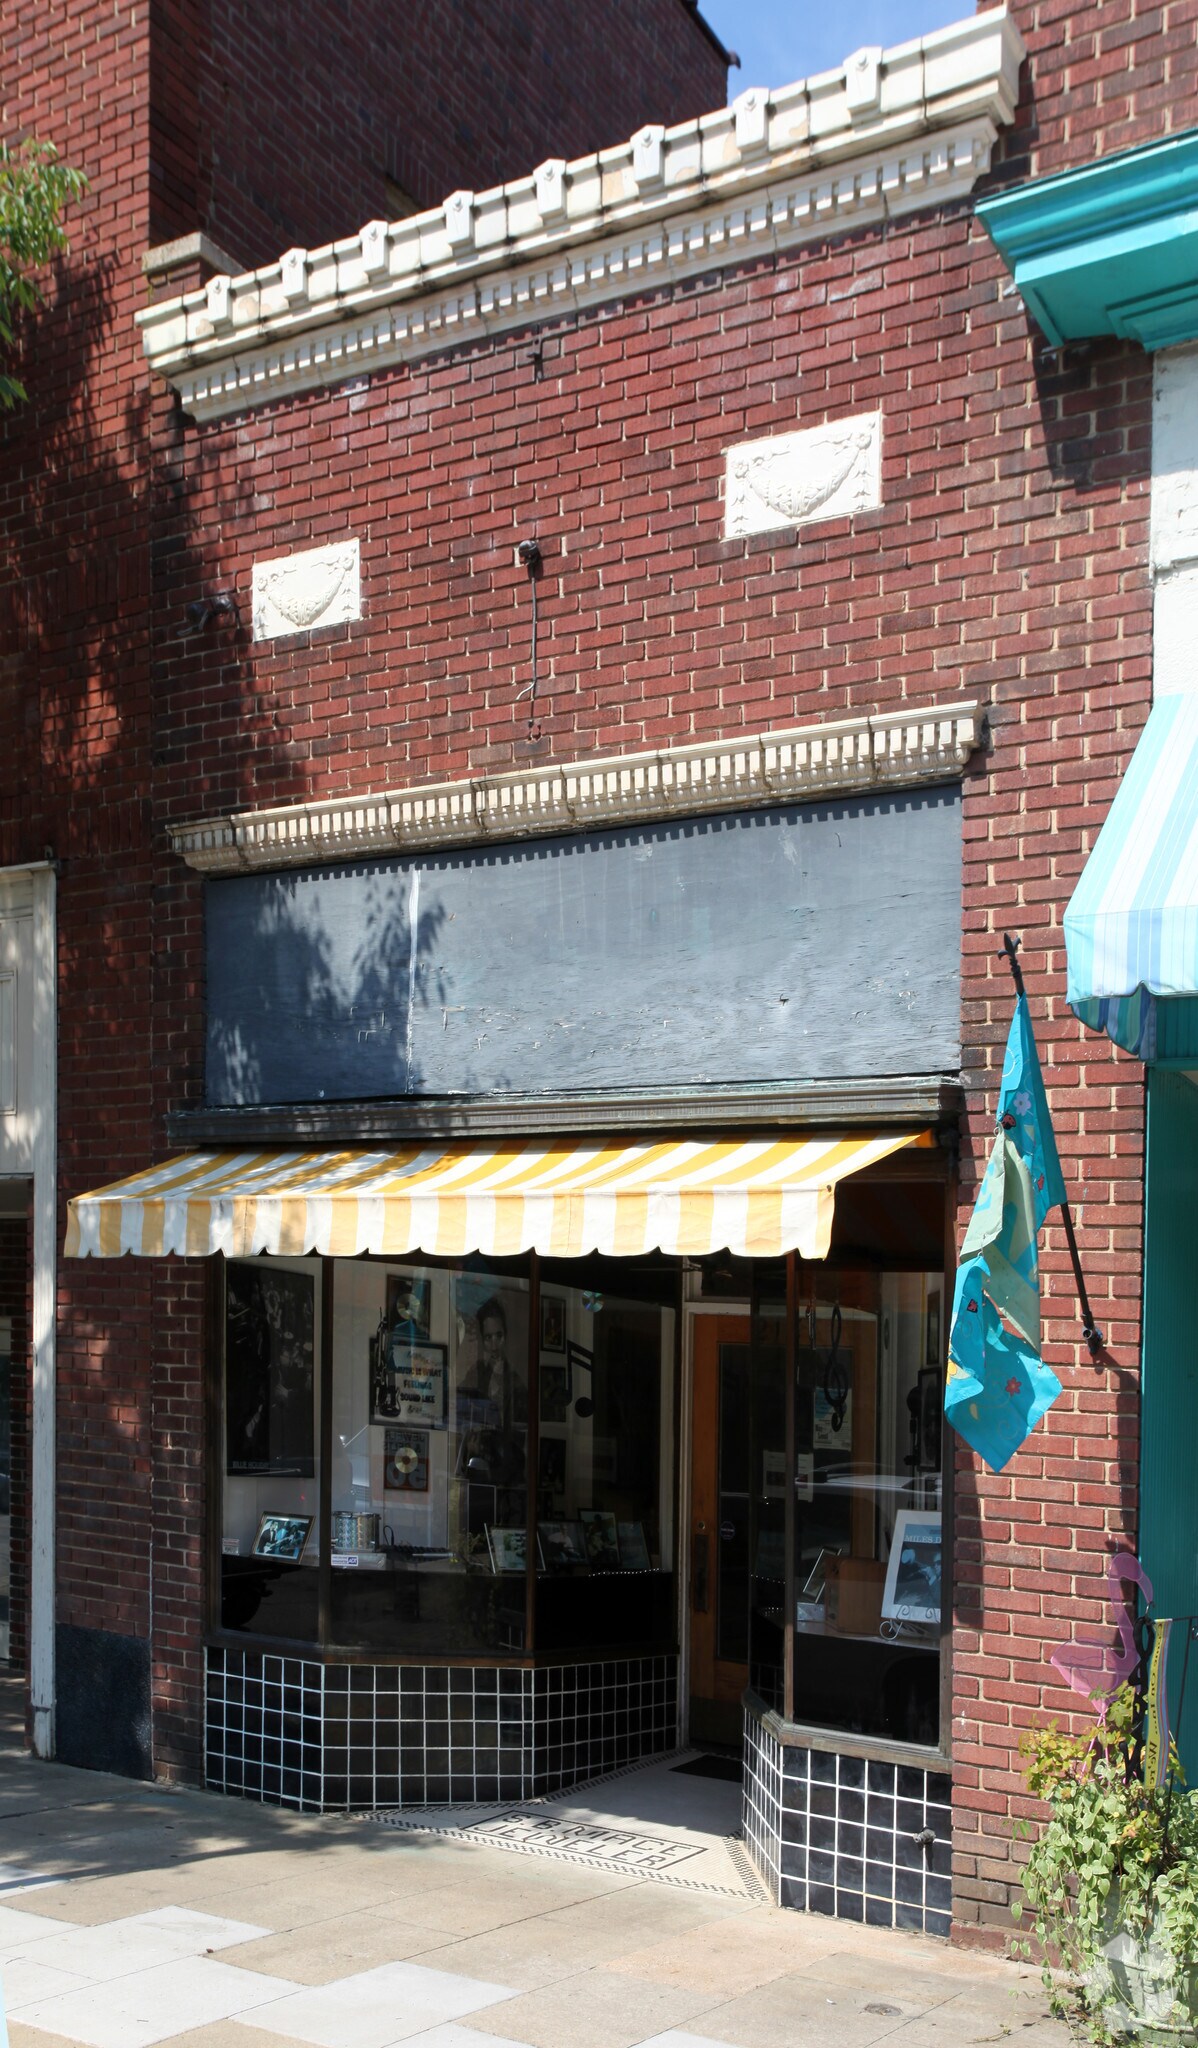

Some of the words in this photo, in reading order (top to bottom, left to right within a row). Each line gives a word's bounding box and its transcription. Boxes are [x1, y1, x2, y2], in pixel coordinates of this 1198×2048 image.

[400, 1393, 421, 1402] SOUND
[422, 1395, 435, 1404] LIKE
[904, 1535, 933, 1543] MILES
[473, 1824, 667, 1866] JEWELER
[562, 1825, 692, 1857] MACE
